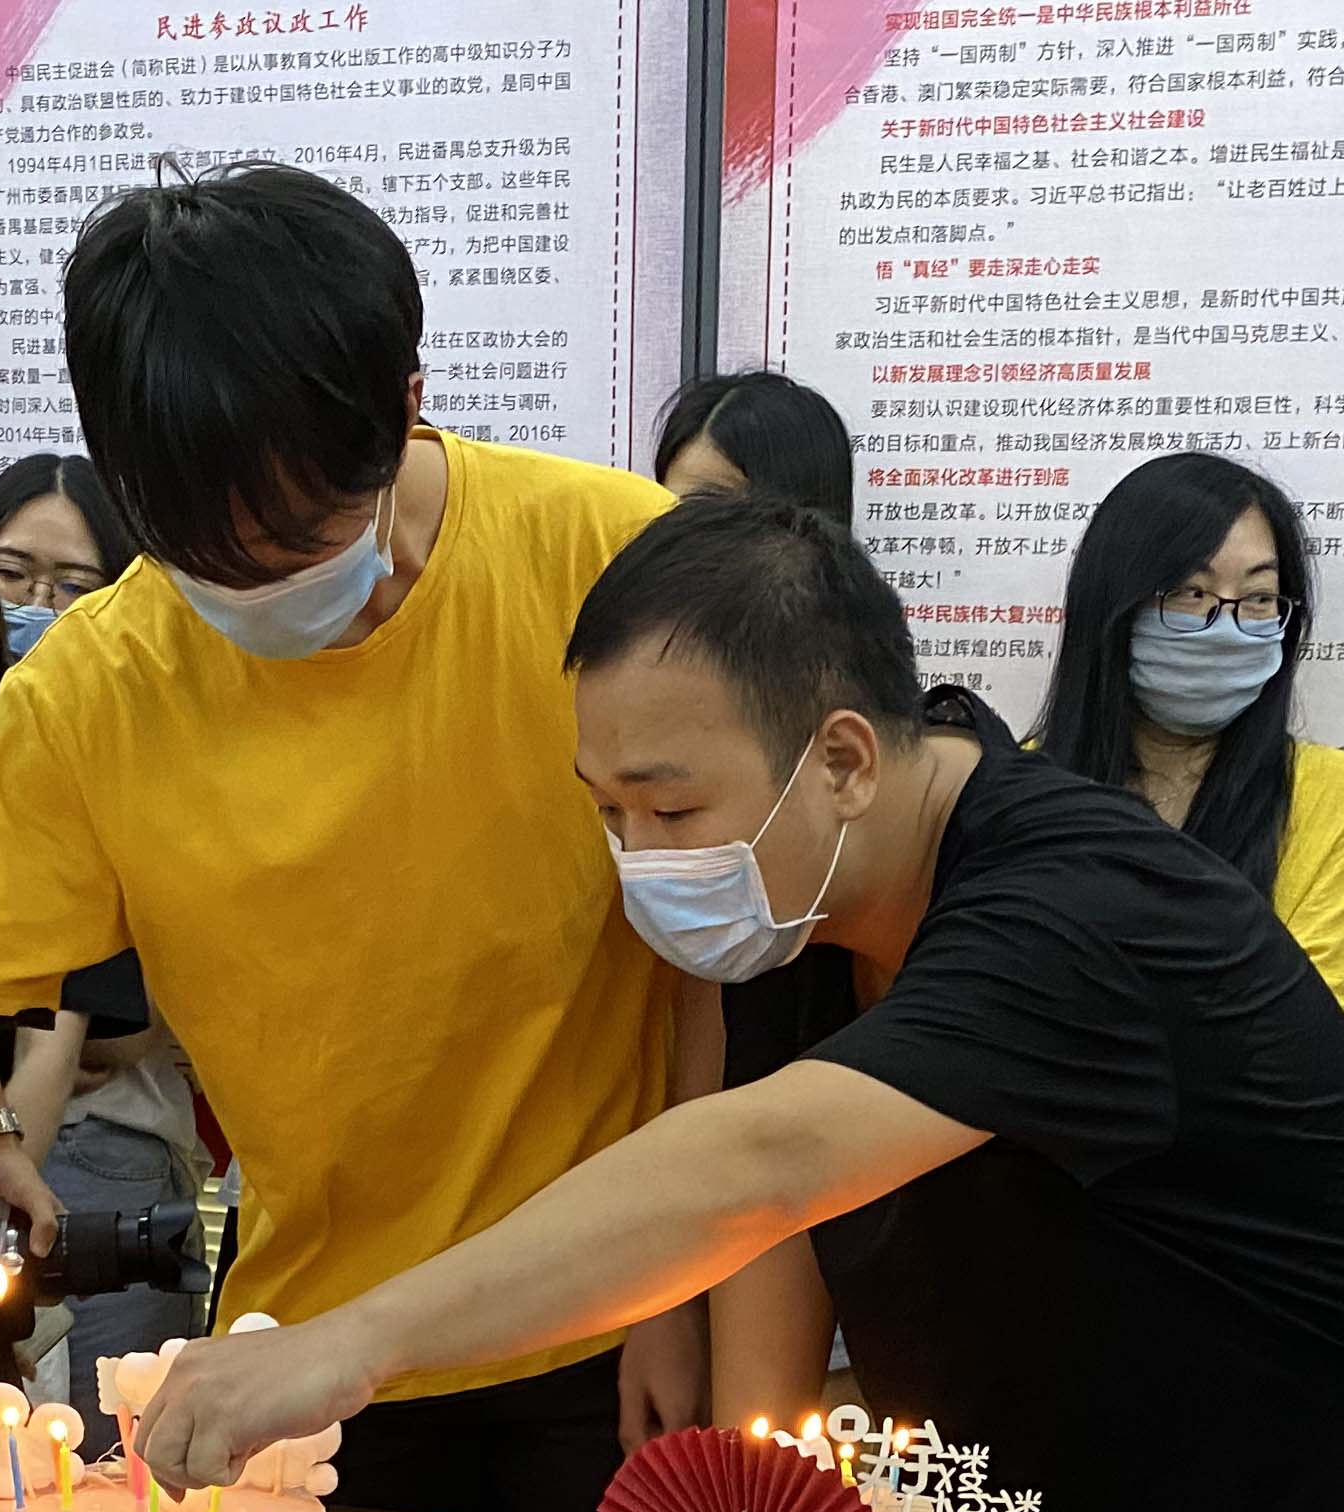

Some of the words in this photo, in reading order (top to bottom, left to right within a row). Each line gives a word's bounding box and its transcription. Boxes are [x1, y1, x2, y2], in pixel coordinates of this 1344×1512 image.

[156, 4, 369, 40] 民进参政议政工作
[881, 108, 1206, 139] 关于新时代中国特色社会主义社会建设
[871, 361, 1152, 384] 以新发展理念引领经济高质量发展
[867, 467, 1070, 488] 将全面深化改革进行到底
[900, 604, 1067, 625] 中华民族伟大复兴的
